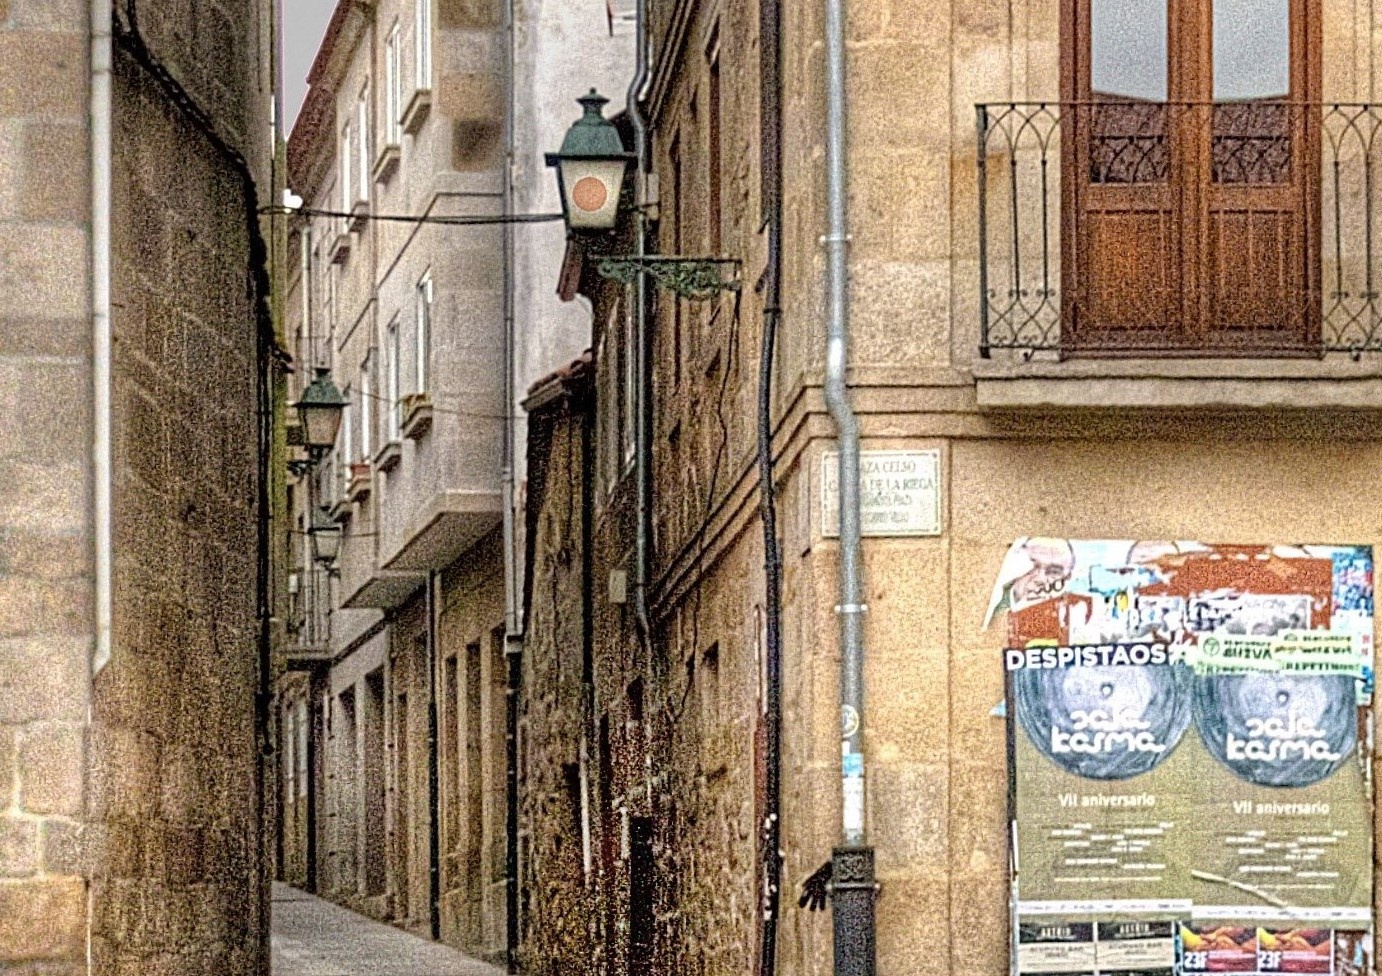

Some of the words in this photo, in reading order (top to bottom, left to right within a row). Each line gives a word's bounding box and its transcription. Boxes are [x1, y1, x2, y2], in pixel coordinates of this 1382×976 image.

[870, 479, 884, 490] DE
[886, 480, 900, 490] LA
[1006, 644, 1167, 670] DESPISTAOS
[1051, 726, 1167, 754] karma
[1227, 733, 1341, 761] karma
[1081, 793, 1156, 807] aniversario
[1255, 801, 1330, 815] aniversario
